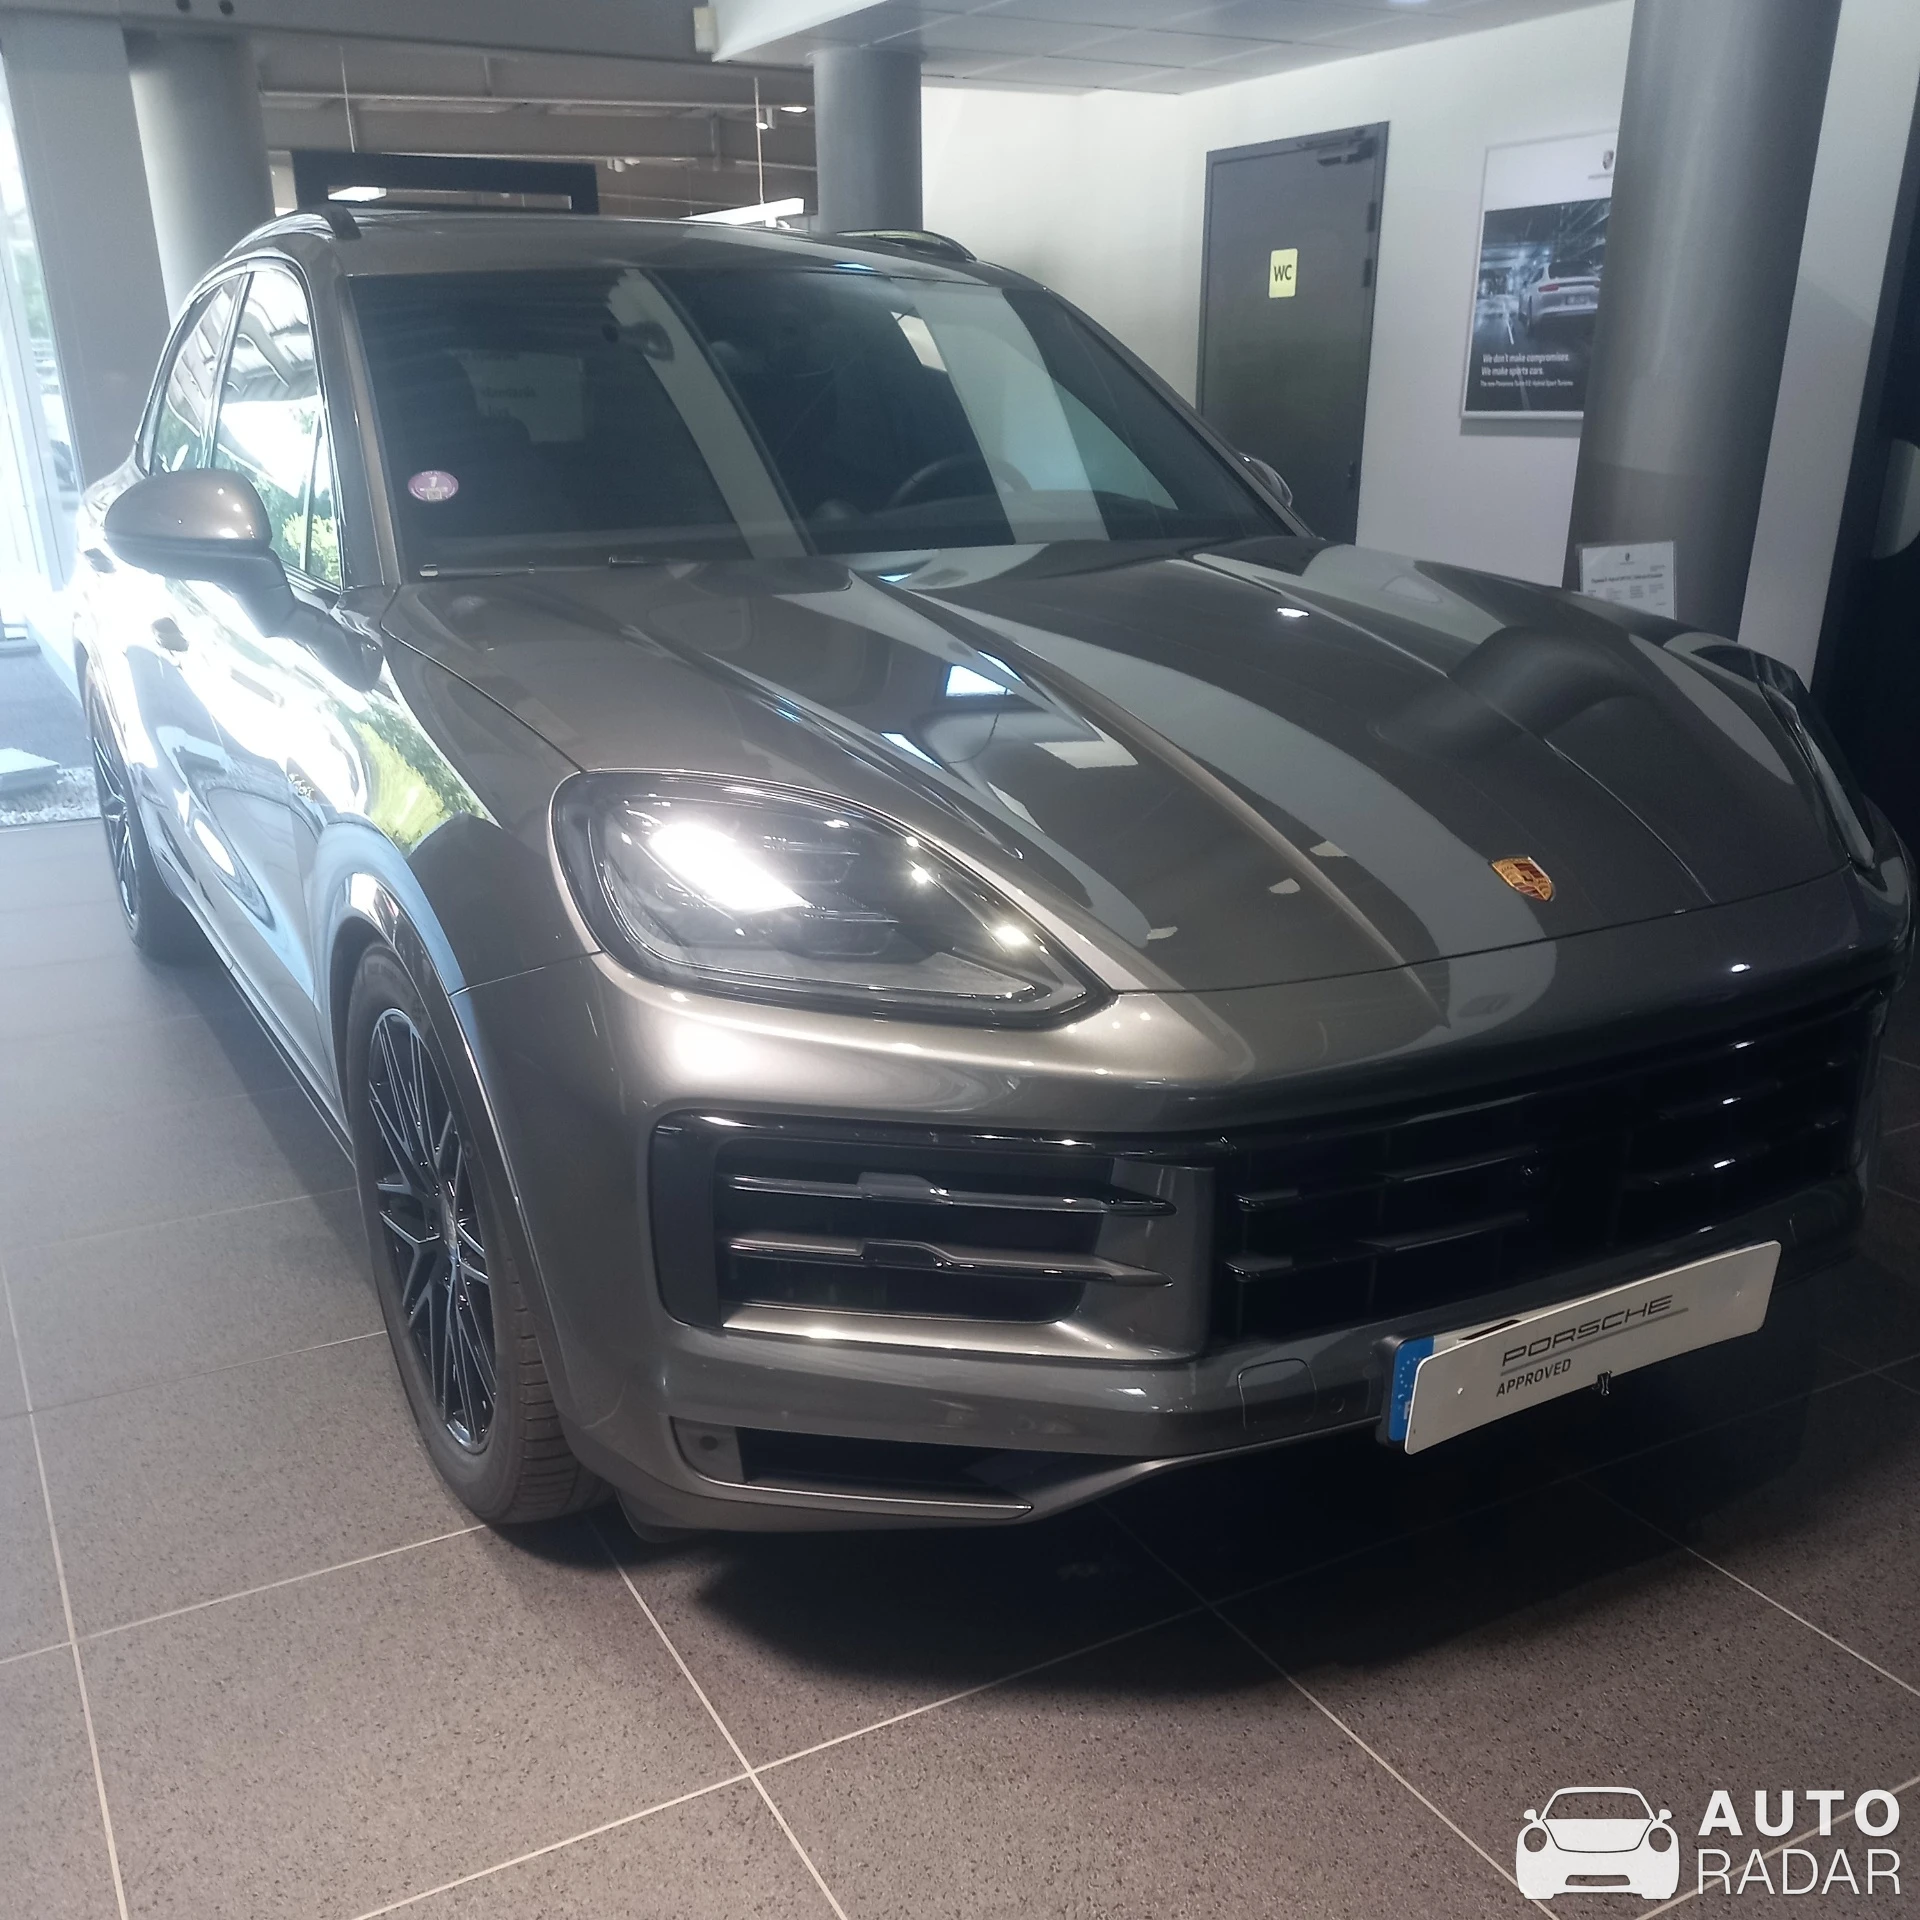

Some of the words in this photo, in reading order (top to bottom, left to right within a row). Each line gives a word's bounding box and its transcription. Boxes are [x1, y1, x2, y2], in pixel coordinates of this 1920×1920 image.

[1273, 264, 1292, 282] WC
[1482, 354, 1493, 363] We
[1509, 353, 1526, 363] make
[1481, 366, 1491, 376] We
[1491, 366, 1508, 376] make
[1502, 1295, 1673, 1367] PORSCHE
[1496, 1358, 1572, 1398] APPROVED
